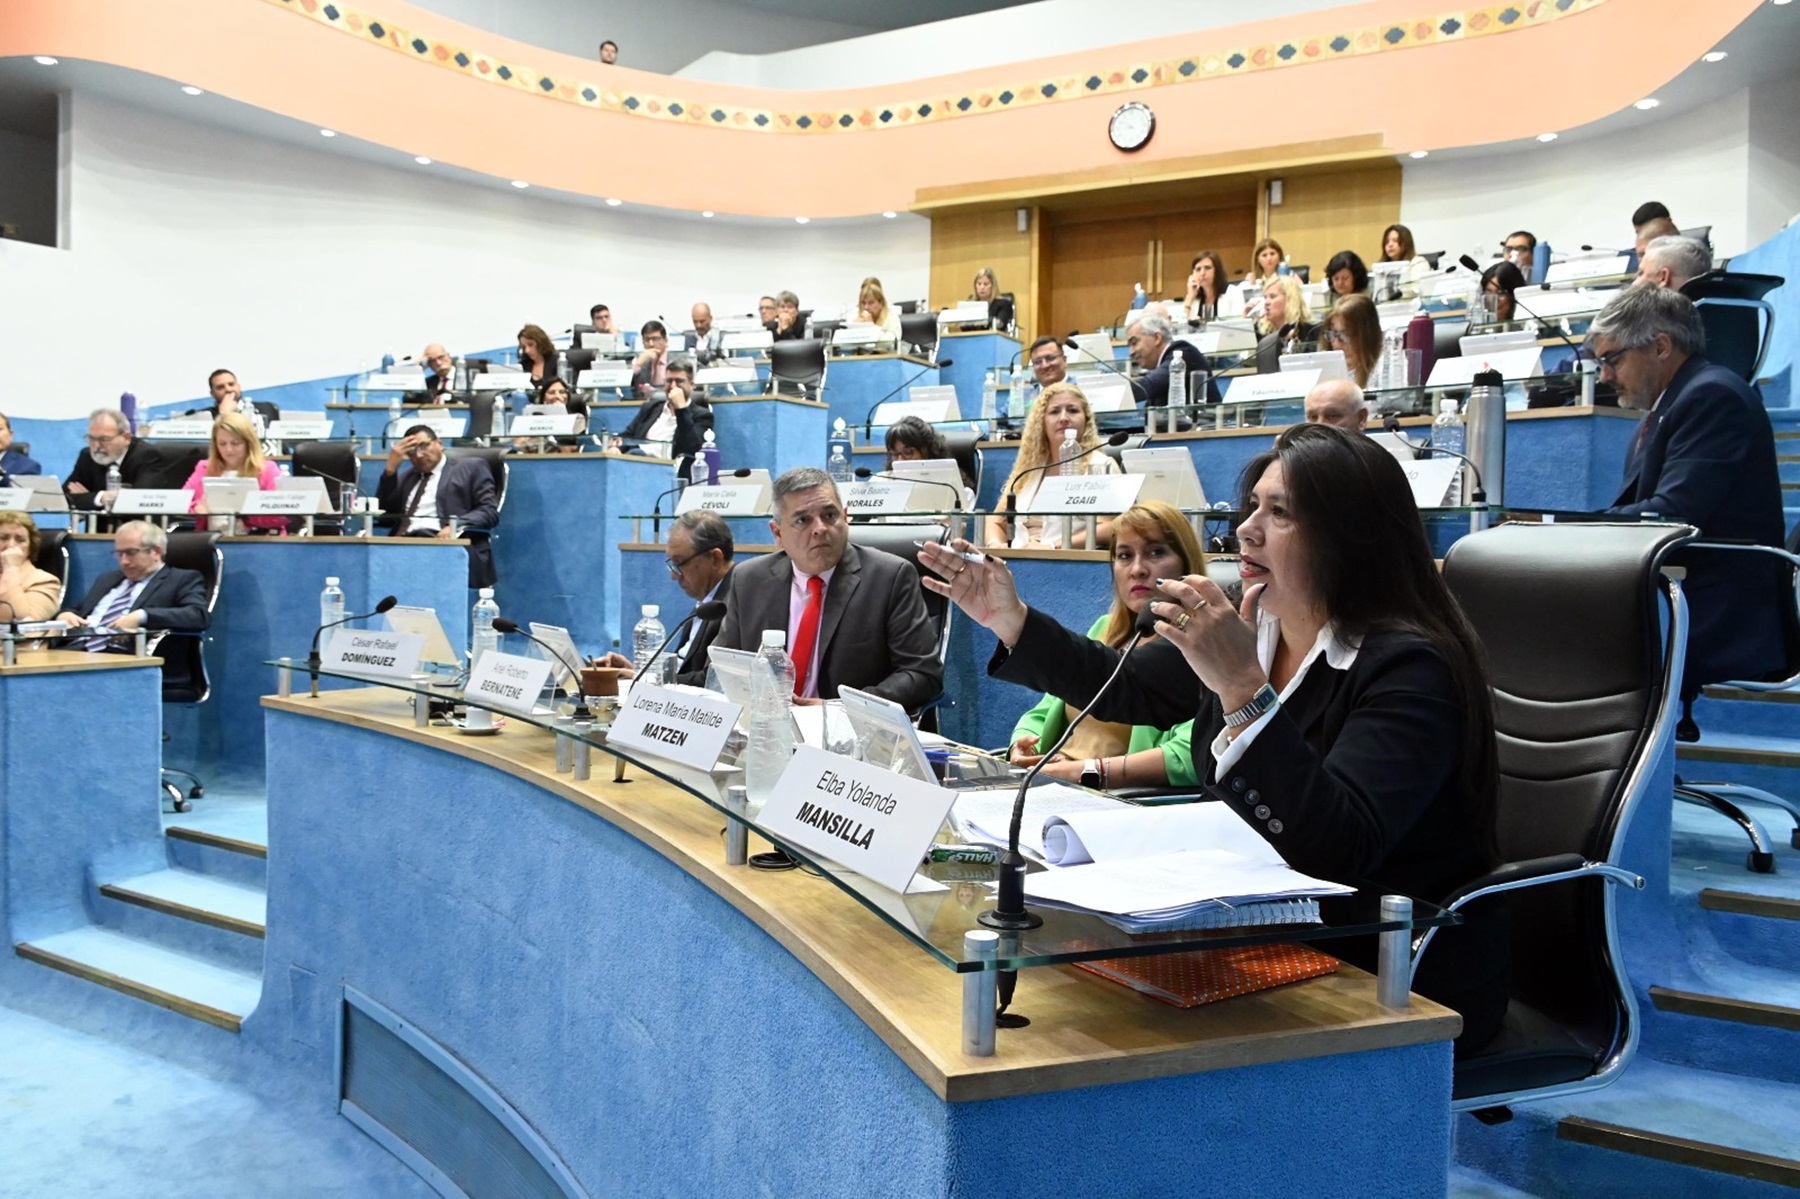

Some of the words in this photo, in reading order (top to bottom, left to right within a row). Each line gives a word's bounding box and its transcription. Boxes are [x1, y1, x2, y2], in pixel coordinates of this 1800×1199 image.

[846, 499, 885, 508] MORALES
[1065, 495, 1098, 505] ZGAIB
[373, 638, 400, 651] Rafael
[341, 652, 397, 668] DOMÍNGUEZ
[480, 679, 524, 700] BERNATENE
[633, 695, 662, 715] Lorena
[688, 706, 724, 729] Matilde
[641, 722, 689, 747] MATZEN
[816, 769, 847, 797] Elba
[846, 779, 898, 816] Yolanda
[795, 801, 876, 851] MANSILLA
[954, 852, 994, 863] HALLS
